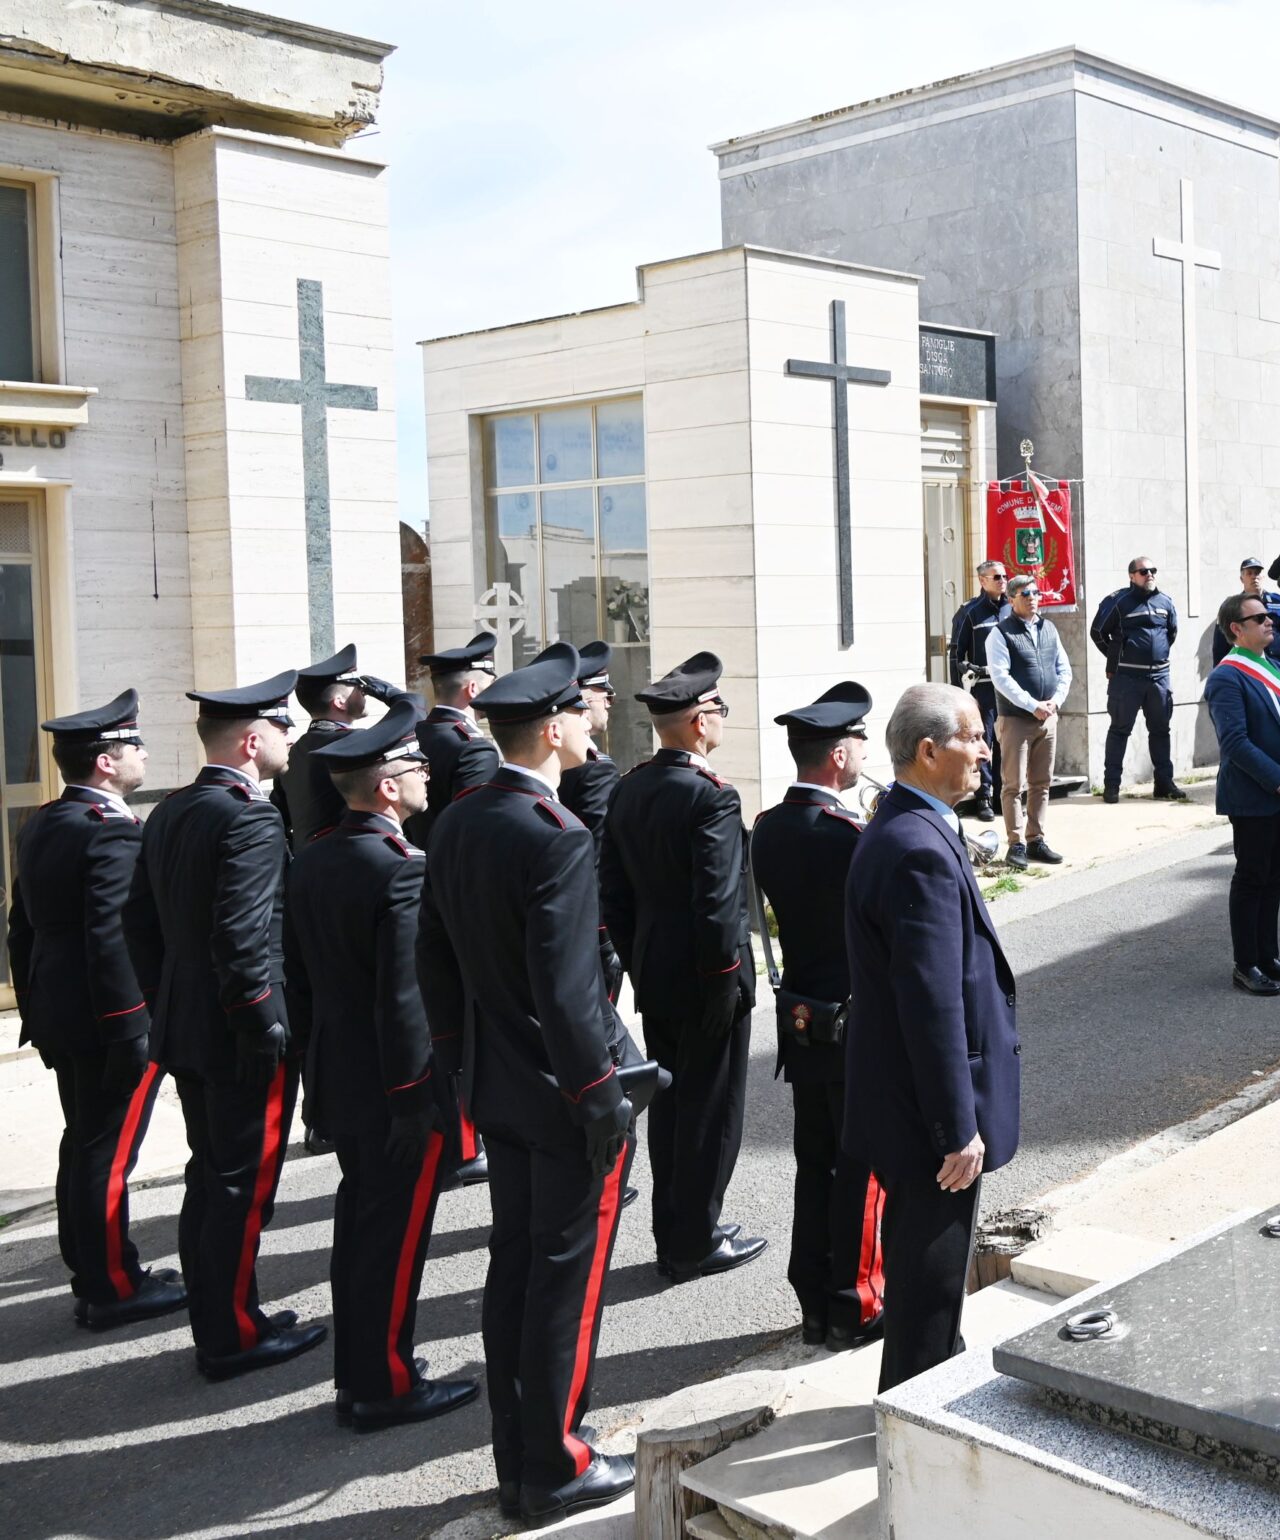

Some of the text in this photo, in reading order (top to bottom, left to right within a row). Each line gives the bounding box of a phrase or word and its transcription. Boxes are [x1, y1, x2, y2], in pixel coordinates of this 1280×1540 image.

[921, 336, 955, 352] FAMIGLIE
[919, 363, 954, 378] SANTORO
[997, 497, 1025, 514] COMUNE
